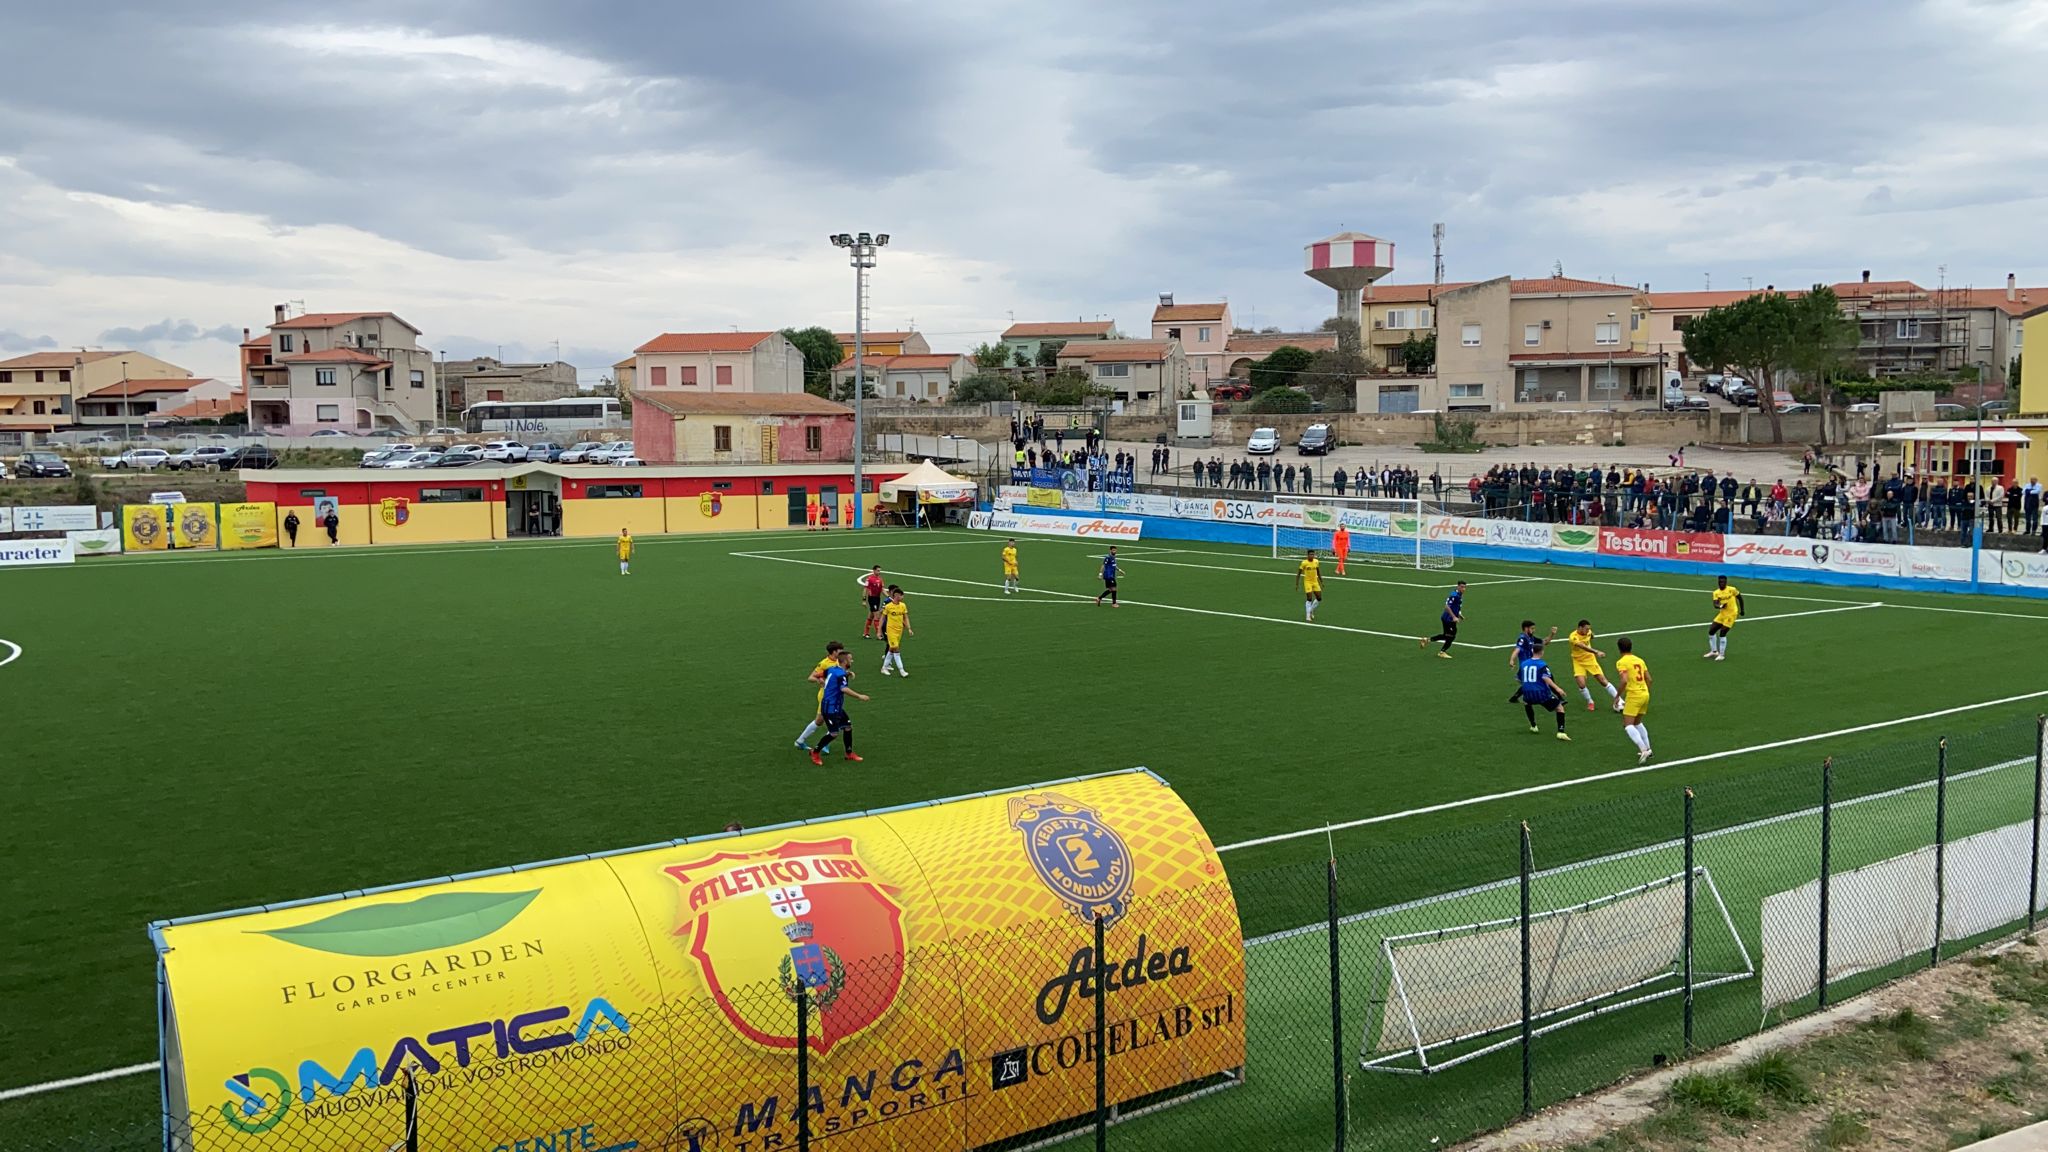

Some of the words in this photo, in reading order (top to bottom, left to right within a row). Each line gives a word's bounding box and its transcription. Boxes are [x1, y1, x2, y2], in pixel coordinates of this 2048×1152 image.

[1226, 502, 1254, 520] GSA
[1256, 506, 1303, 520] Ardea
[1077, 520, 1139, 535] Ardea
[1509, 527, 1549, 538] MANCA
[1602, 531, 1668, 555] Testoni
[1725, 542, 1808, 557] Ardea
[1523, 665, 1538, 683] 10
[1633, 664, 1643, 682] 3
[1037, 819, 1090, 848] VEDETTA
[1092, 827, 1104, 839] 2
[1065, 836, 1101, 872] 2
[689, 859, 810, 912] ATLETICO
[812, 858, 870, 881] URI
[1050, 856, 1122, 898] MONDIALPOL
[281, 939, 545, 1005] FLORGARDEN
[1036, 932, 1193, 1025] Ardea
[336, 987, 417, 1012] GARDEN
[432, 970, 507, 992] CENTER
[1202, 993, 1234, 1030] srl
[441, 1075, 460, 1090] IL
[463, 1053, 548, 1084] VOSTRO
[551, 1035, 633, 1064] MONDO
[733, 1048, 966, 1137] MANCA
